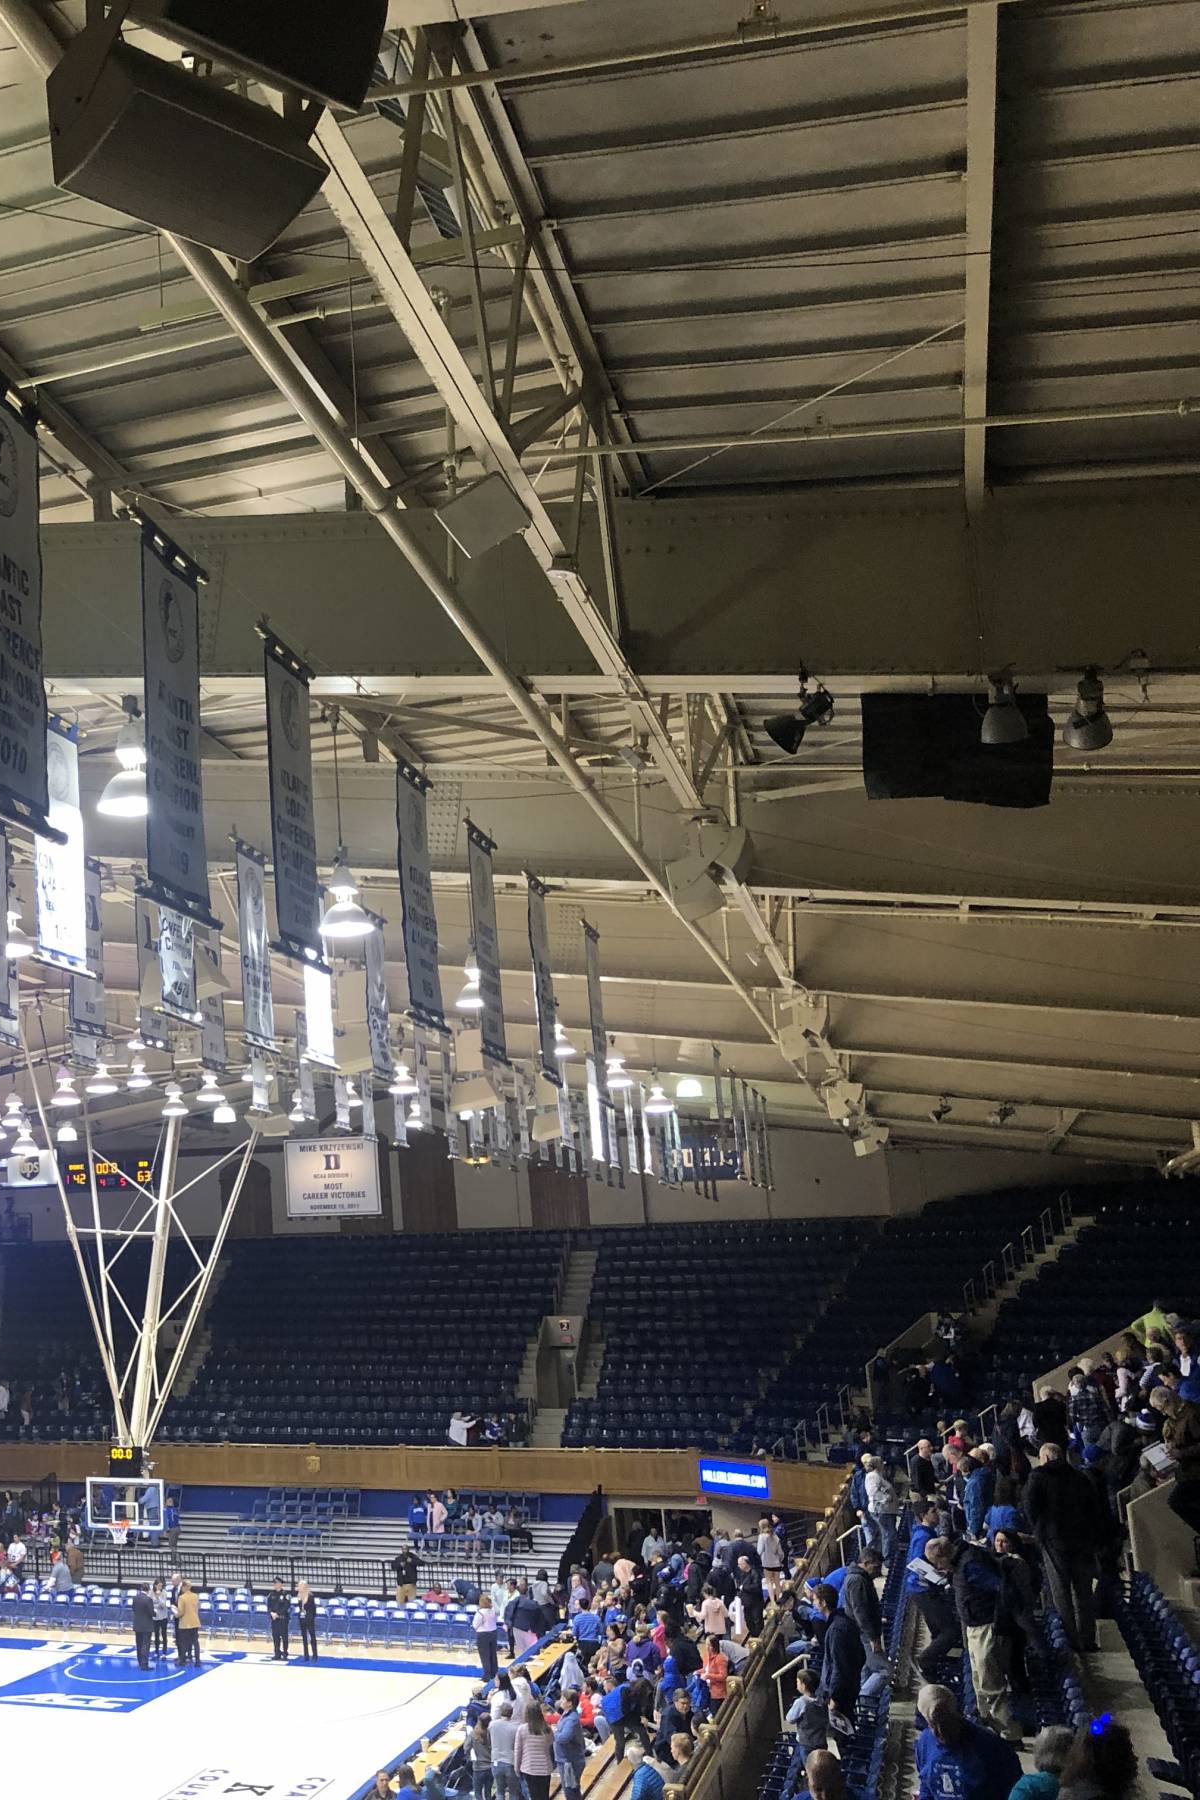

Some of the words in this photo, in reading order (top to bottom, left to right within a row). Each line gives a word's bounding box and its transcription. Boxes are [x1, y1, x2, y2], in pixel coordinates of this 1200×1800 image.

[299, 1144, 317, 1152] MIKE
[73, 1173, 87, 1185] 42
[136, 1170, 151, 1182] 63
[302, 1192, 328, 1200] CAREER
[330, 1191, 366, 1199] VICTORIES
[111, 1448, 133, 1460] 00.0
